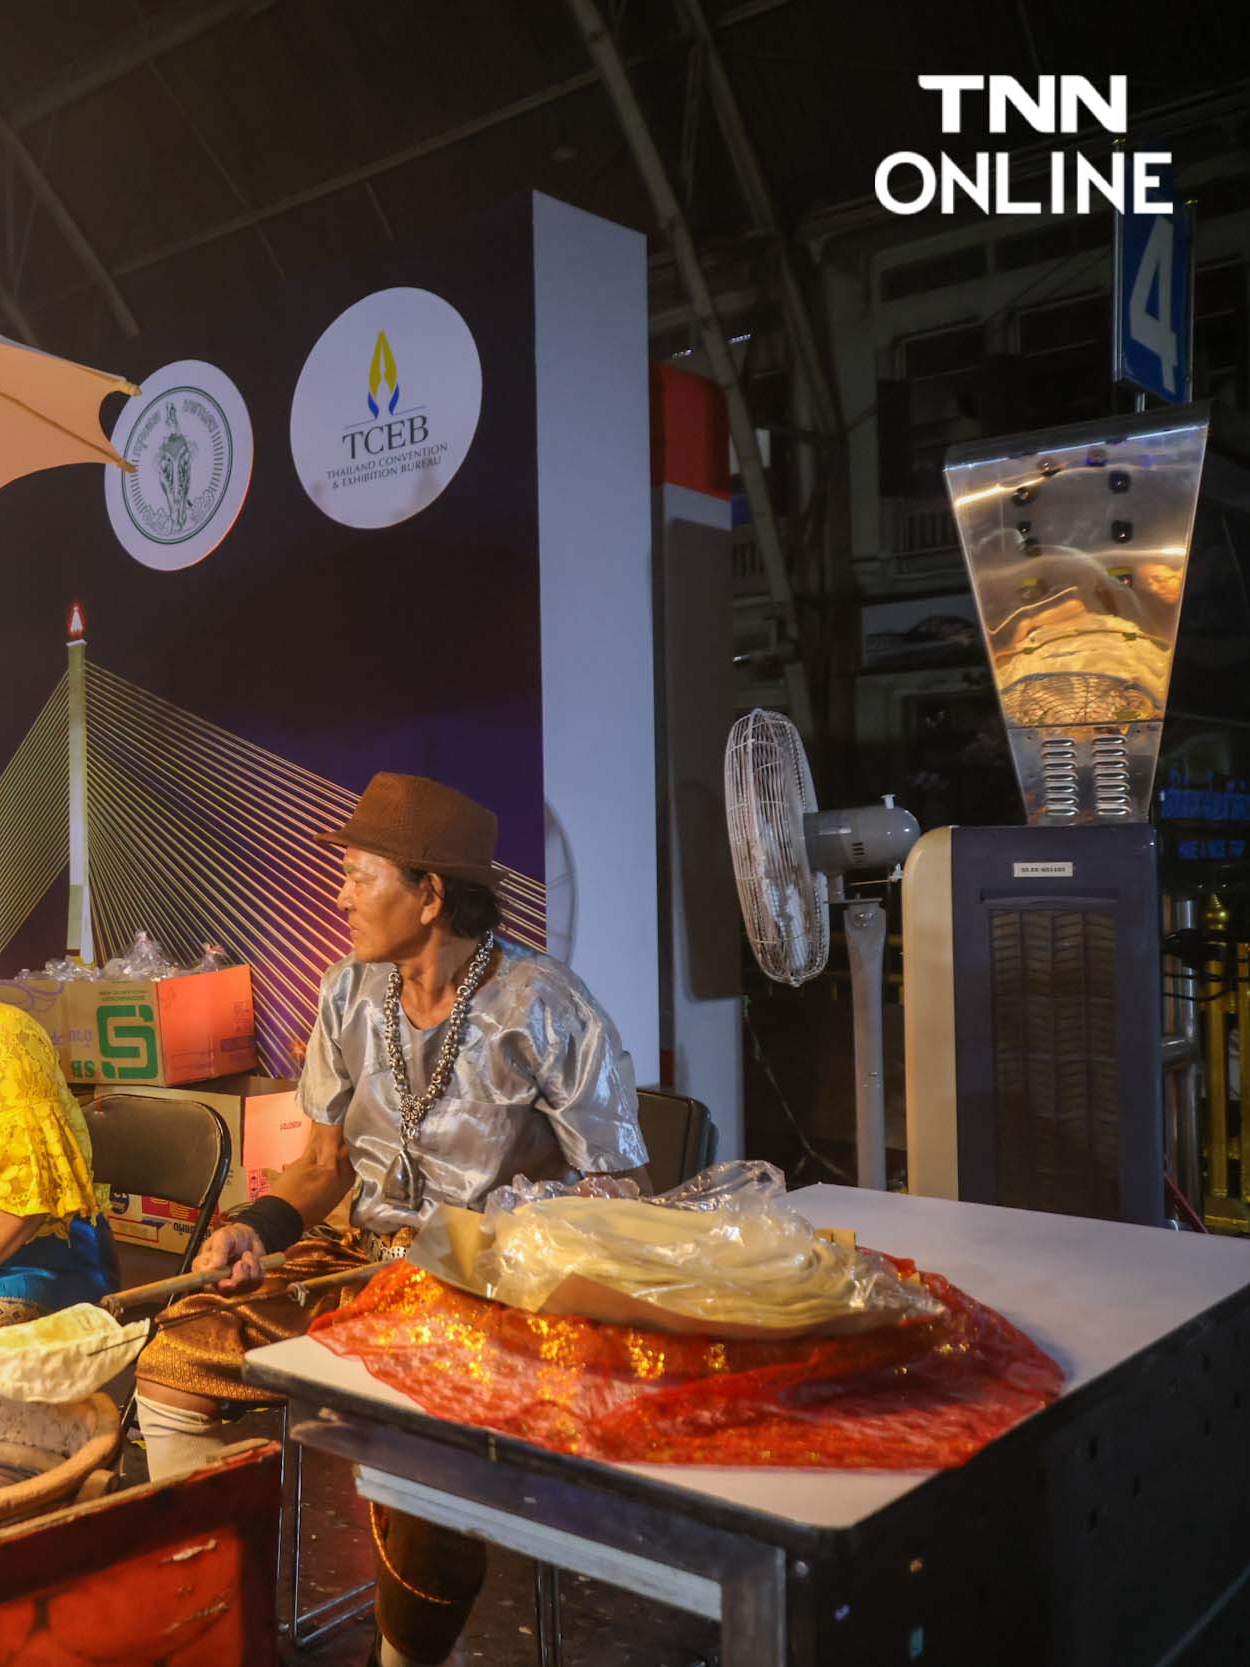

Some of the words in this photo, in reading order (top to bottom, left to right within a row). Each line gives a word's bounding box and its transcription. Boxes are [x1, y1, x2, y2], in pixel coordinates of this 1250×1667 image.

[1129, 214, 1178, 395] 4
[342, 415, 429, 459] TCEB
[327, 461, 376, 479] THAILAND
[378, 442, 448, 467] CONVENTION
[332, 481, 339, 489] &
[342, 468, 398, 486] EXHIBITION
[401, 455, 442, 473] BUREAU
